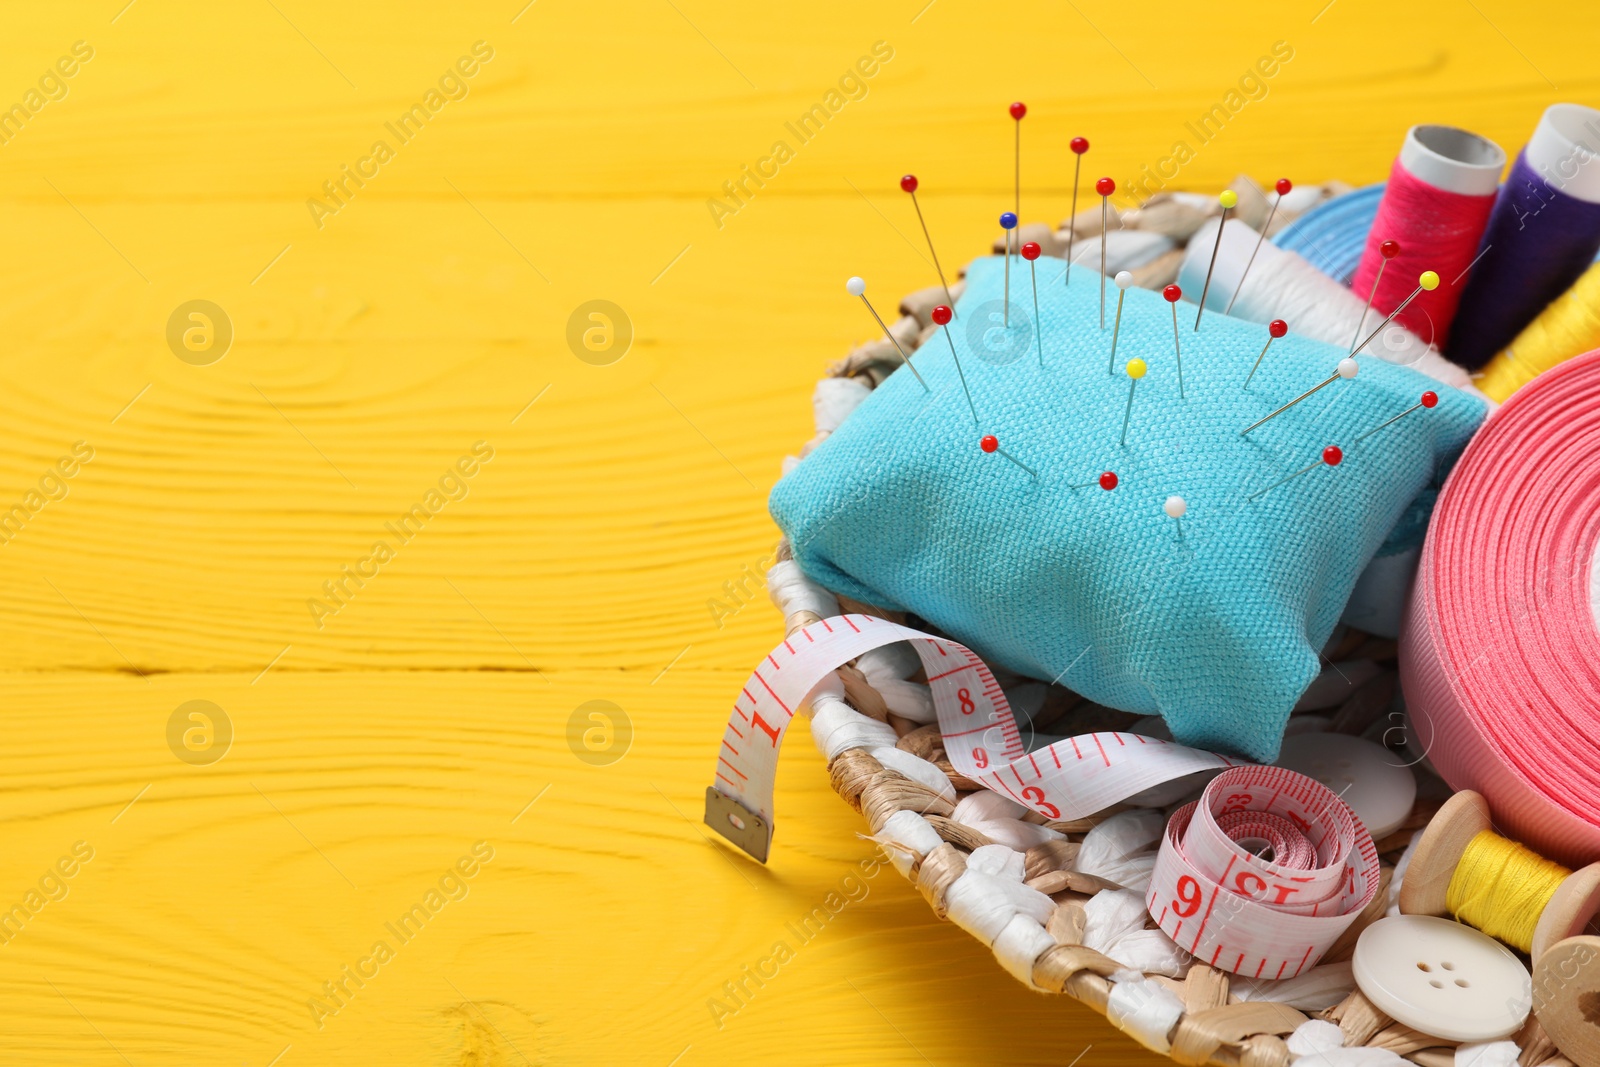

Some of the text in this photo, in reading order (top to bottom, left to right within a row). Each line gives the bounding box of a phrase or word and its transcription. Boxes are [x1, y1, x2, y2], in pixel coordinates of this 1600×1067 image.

[957, 688, 975, 715] 8
[751, 710, 781, 748] 1
[972, 747, 989, 769] 9
[1021, 786, 1060, 819] 3
